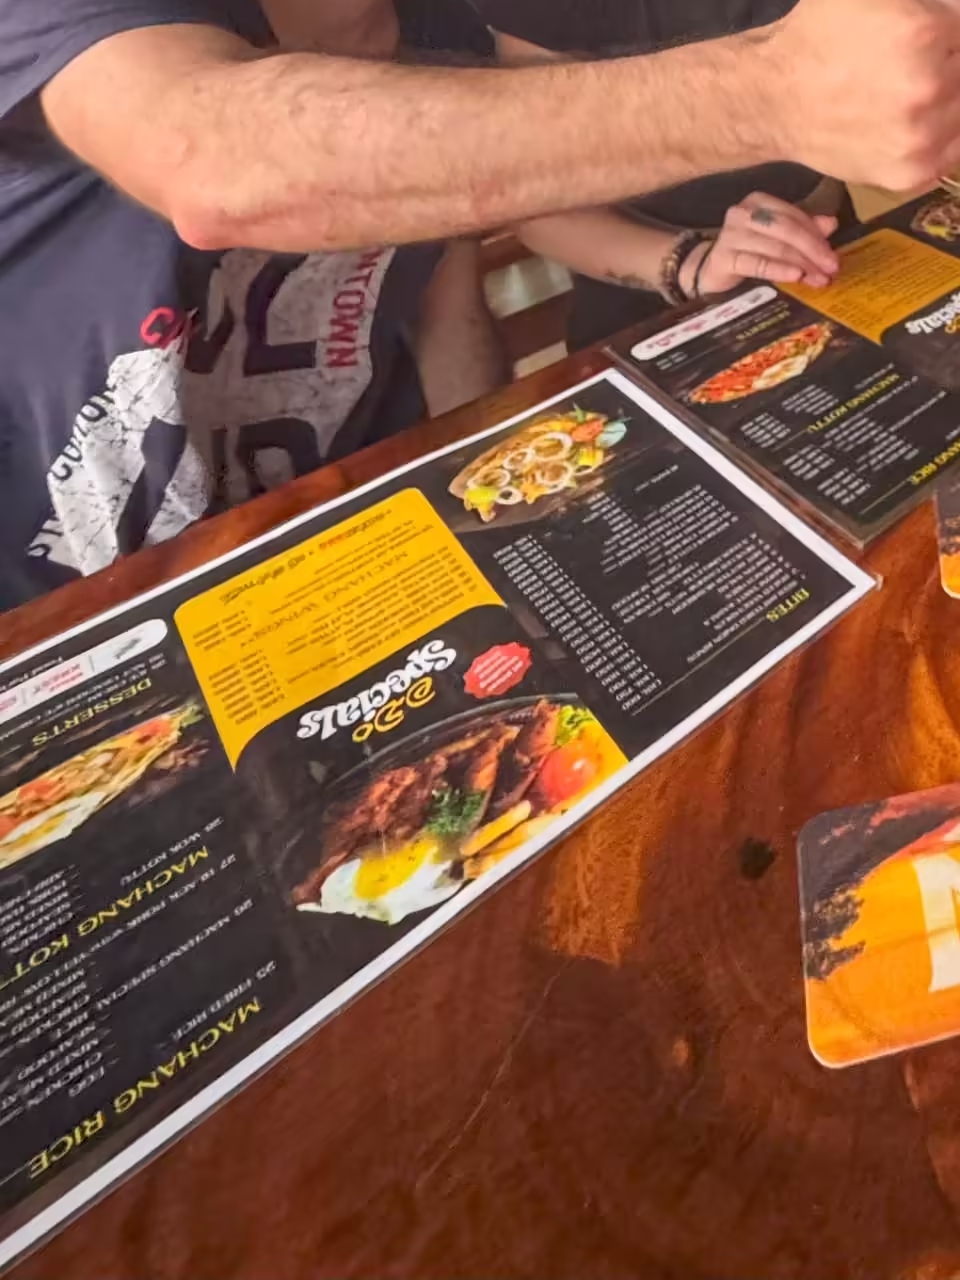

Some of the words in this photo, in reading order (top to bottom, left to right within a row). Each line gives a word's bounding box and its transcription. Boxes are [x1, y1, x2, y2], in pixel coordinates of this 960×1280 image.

[766, 588, 809, 621] BITES
[32, 675, 151, 745] DESSERTS
[296, 639, 457, 741] Specials
[78, 846, 208, 936] MACHANG
[114, 997, 260, 1113] MACHANG
[28, 1111, 104, 1178] RICE
